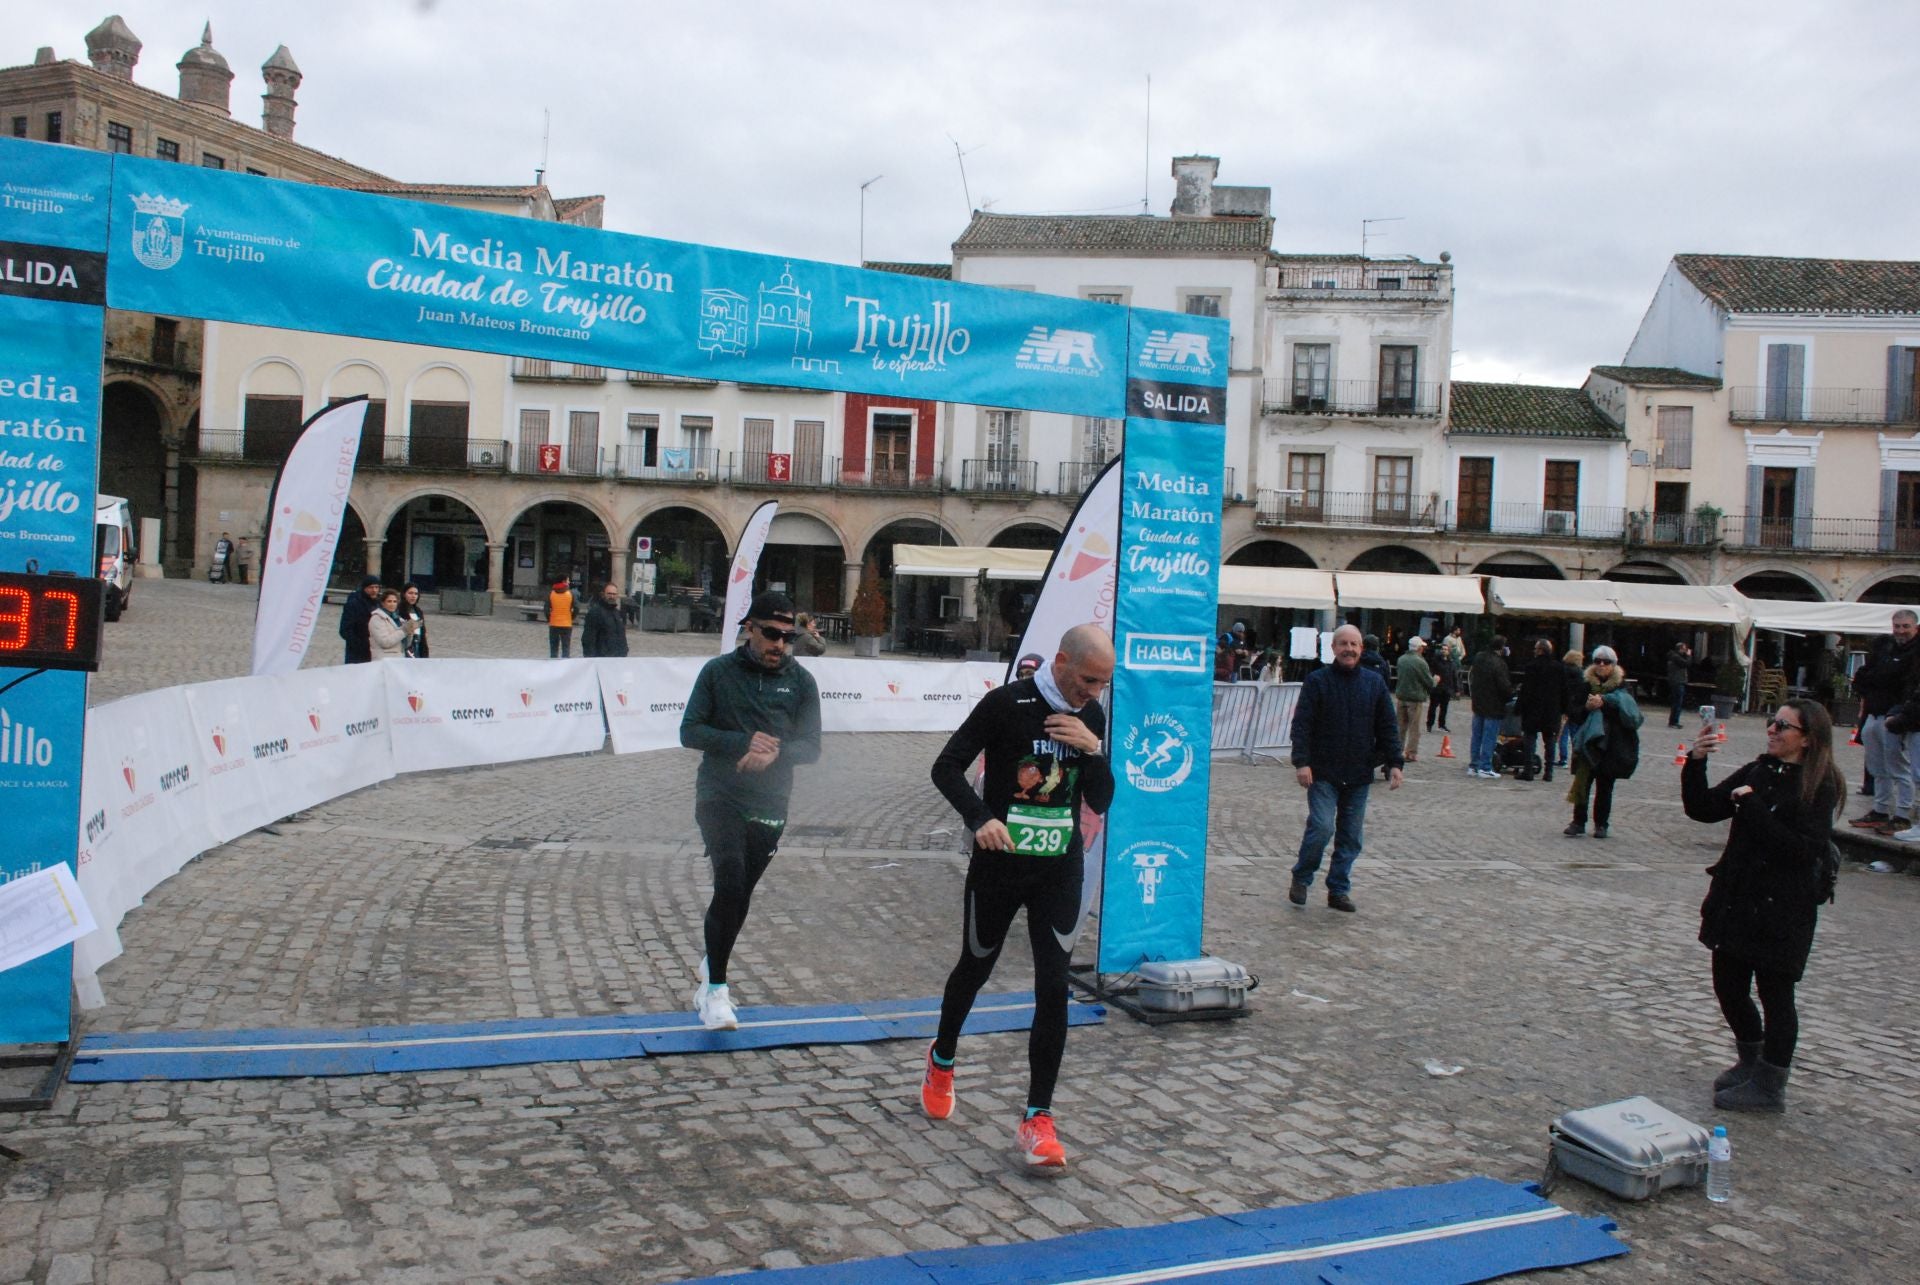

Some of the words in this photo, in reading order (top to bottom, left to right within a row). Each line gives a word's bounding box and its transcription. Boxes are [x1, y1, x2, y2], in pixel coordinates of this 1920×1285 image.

[3, 195, 64, 215] Trujillo
[4, 182, 80, 201] Ayuntamiento
[81, 192, 95, 203] de
[195, 224, 284, 248] Ayuntamiento
[285, 239, 301, 250] de
[193, 239, 266, 264] Trujillo
[410, 227, 523, 273] Media
[533, 247, 675, 293] Maratón
[0, 258, 79, 289] LIDA
[366, 258, 487, 302] Ciudad
[490, 278, 533, 308] de
[539, 282, 647, 329] Trujillo
[417, 306, 455, 324] Juan
[458, 310, 516, 332] Mateos
[519, 318, 591, 341] Broncano
[844, 295, 971, 366] Trujillo
[872, 349, 888, 371] te
[1015, 361, 1101, 378] www.musicrun.es
[1143, 391, 1211, 414] SALIDA
[37, 454, 65, 472] de
[1136, 471, 1210, 496] Media
[0, 479, 80, 522] jillo
[1131, 500, 1215, 524] Maratón
[19, 530, 76, 543] Broncano
[323, 522, 338, 546] DE
[1139, 527, 1182, 545] Ciudad
[1183, 531, 1200, 546] de
[1127, 545, 1210, 583] Trujillo
[1136, 644, 1194, 662] HABLA
[1123, 723, 1139, 751] Club
[1143, 711, 1189, 738] Atletismo
[1016, 826, 1062, 852] 239
